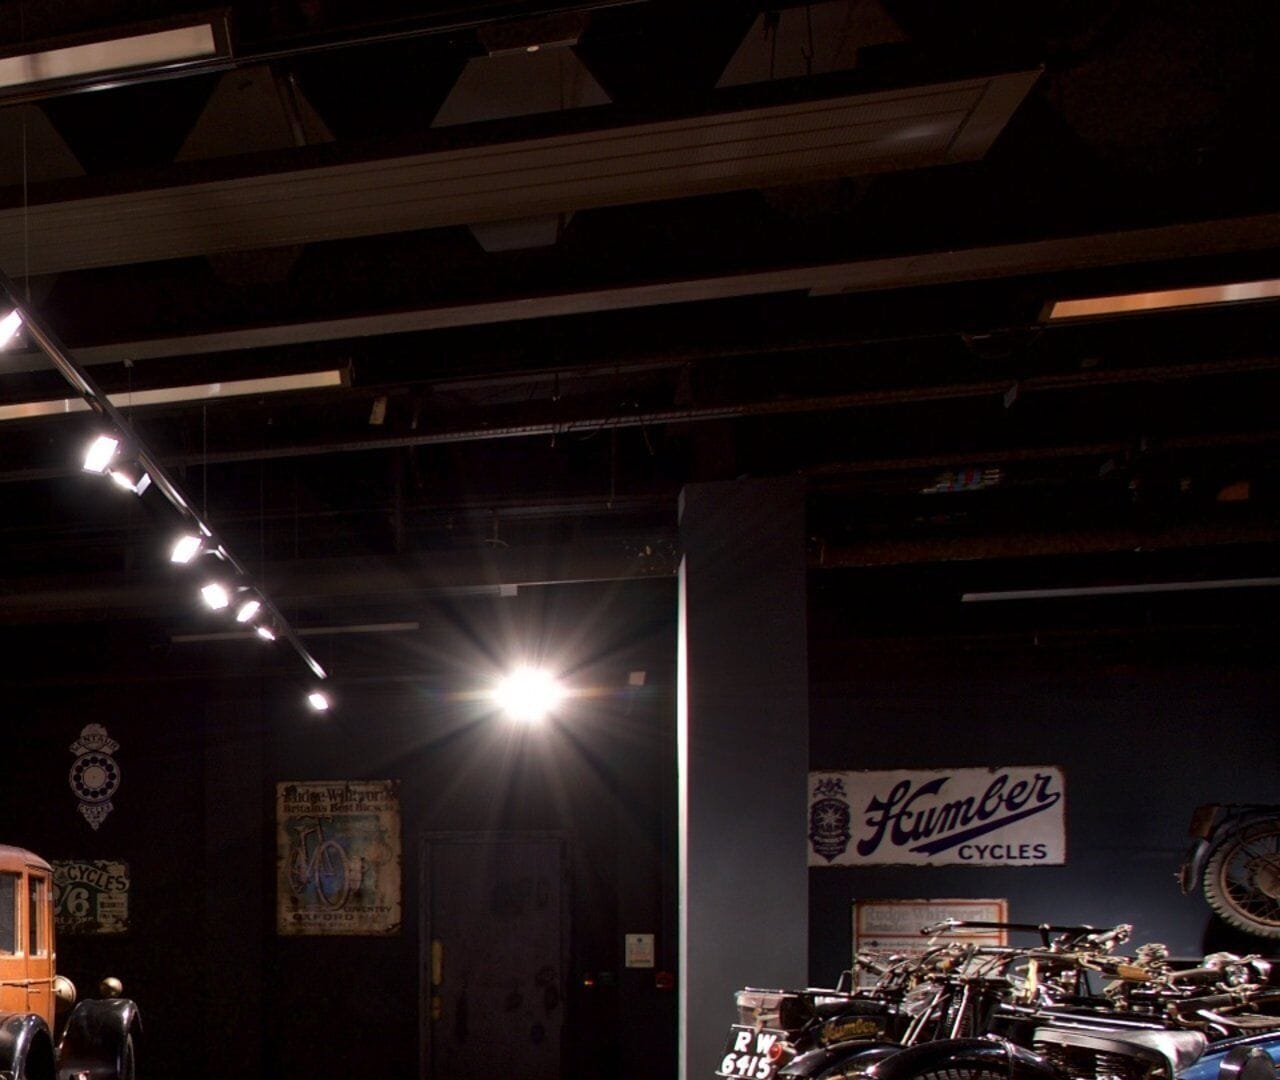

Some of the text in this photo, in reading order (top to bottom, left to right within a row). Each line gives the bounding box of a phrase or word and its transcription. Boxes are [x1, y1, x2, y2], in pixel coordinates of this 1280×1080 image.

[856, 773, 1061, 858] Humber
[958, 843, 1048, 861] CYCLES
[67, 865, 127, 892] CYCLES
[721, 1053, 772, 1080] 6415
